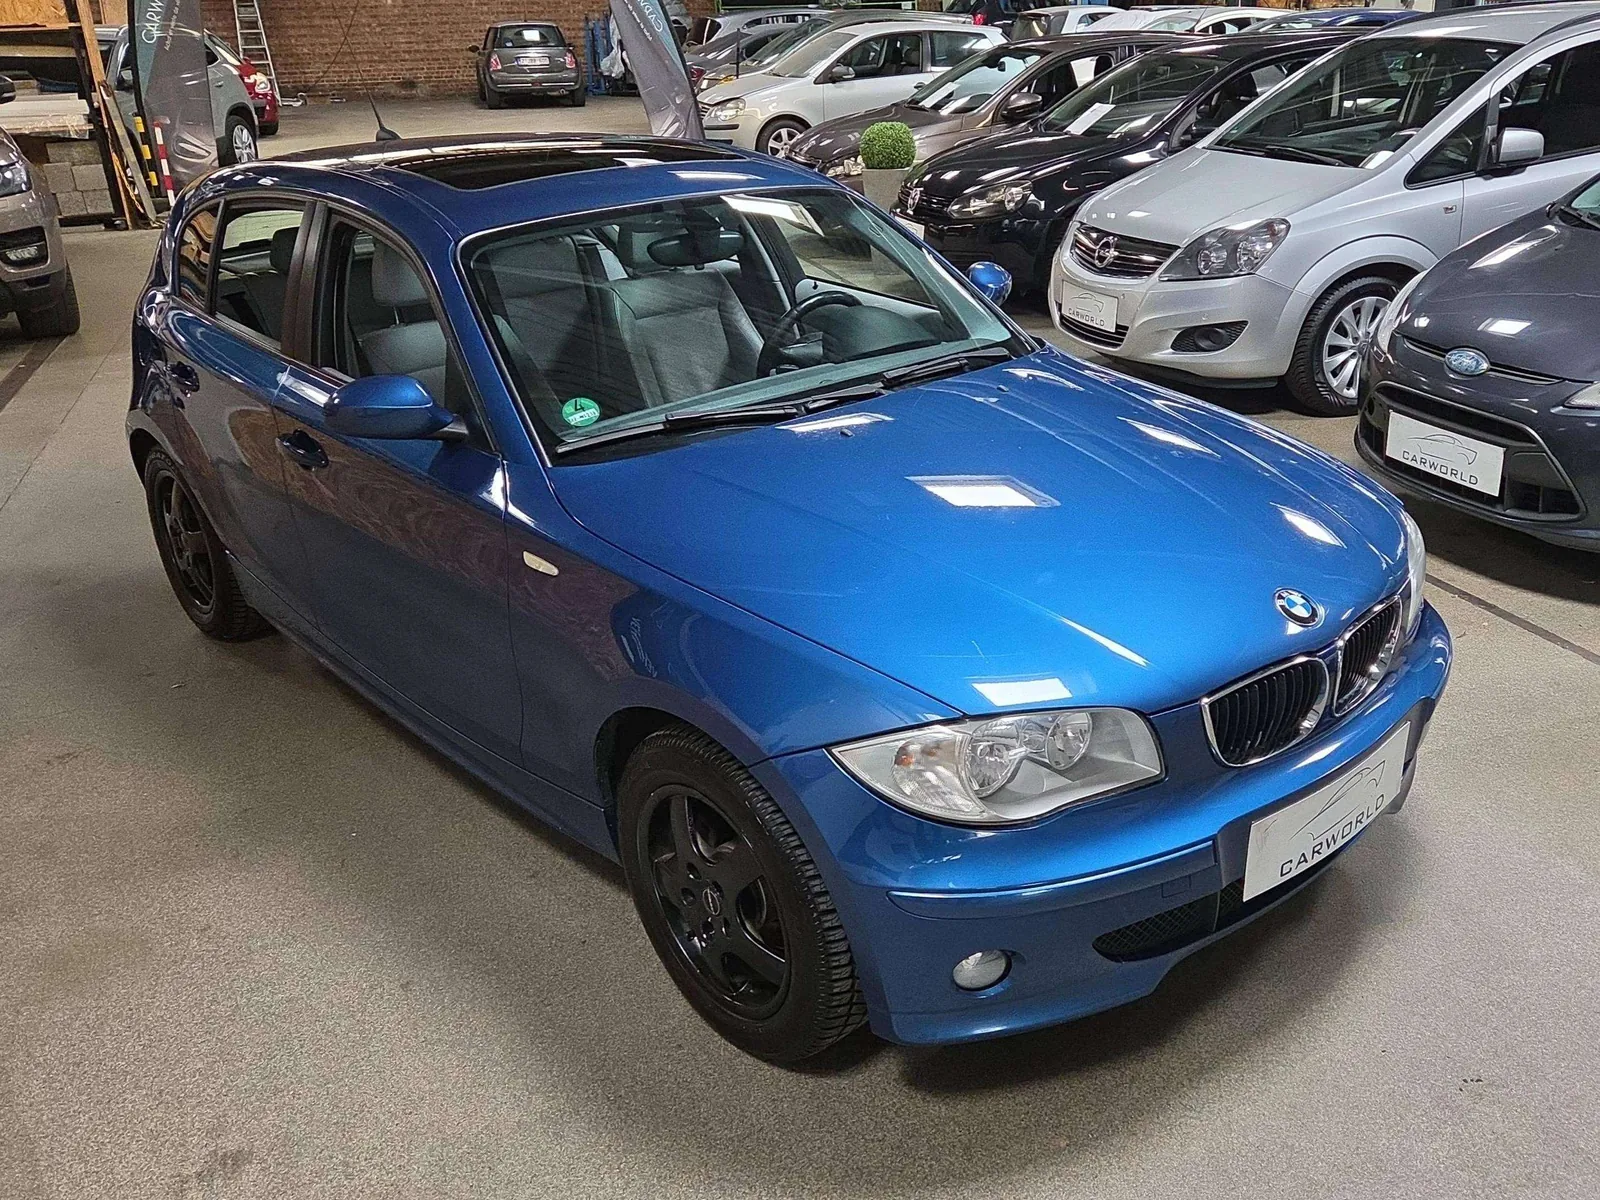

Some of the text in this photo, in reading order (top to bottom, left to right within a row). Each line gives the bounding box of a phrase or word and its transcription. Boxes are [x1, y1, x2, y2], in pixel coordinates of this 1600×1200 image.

[1069, 307, 1105, 327] CARWORLD
[575, 399, 585, 412] 4
[1402, 450, 1478, 485] CARWORLD
[1279, 793, 1385, 878] CARWORLD
